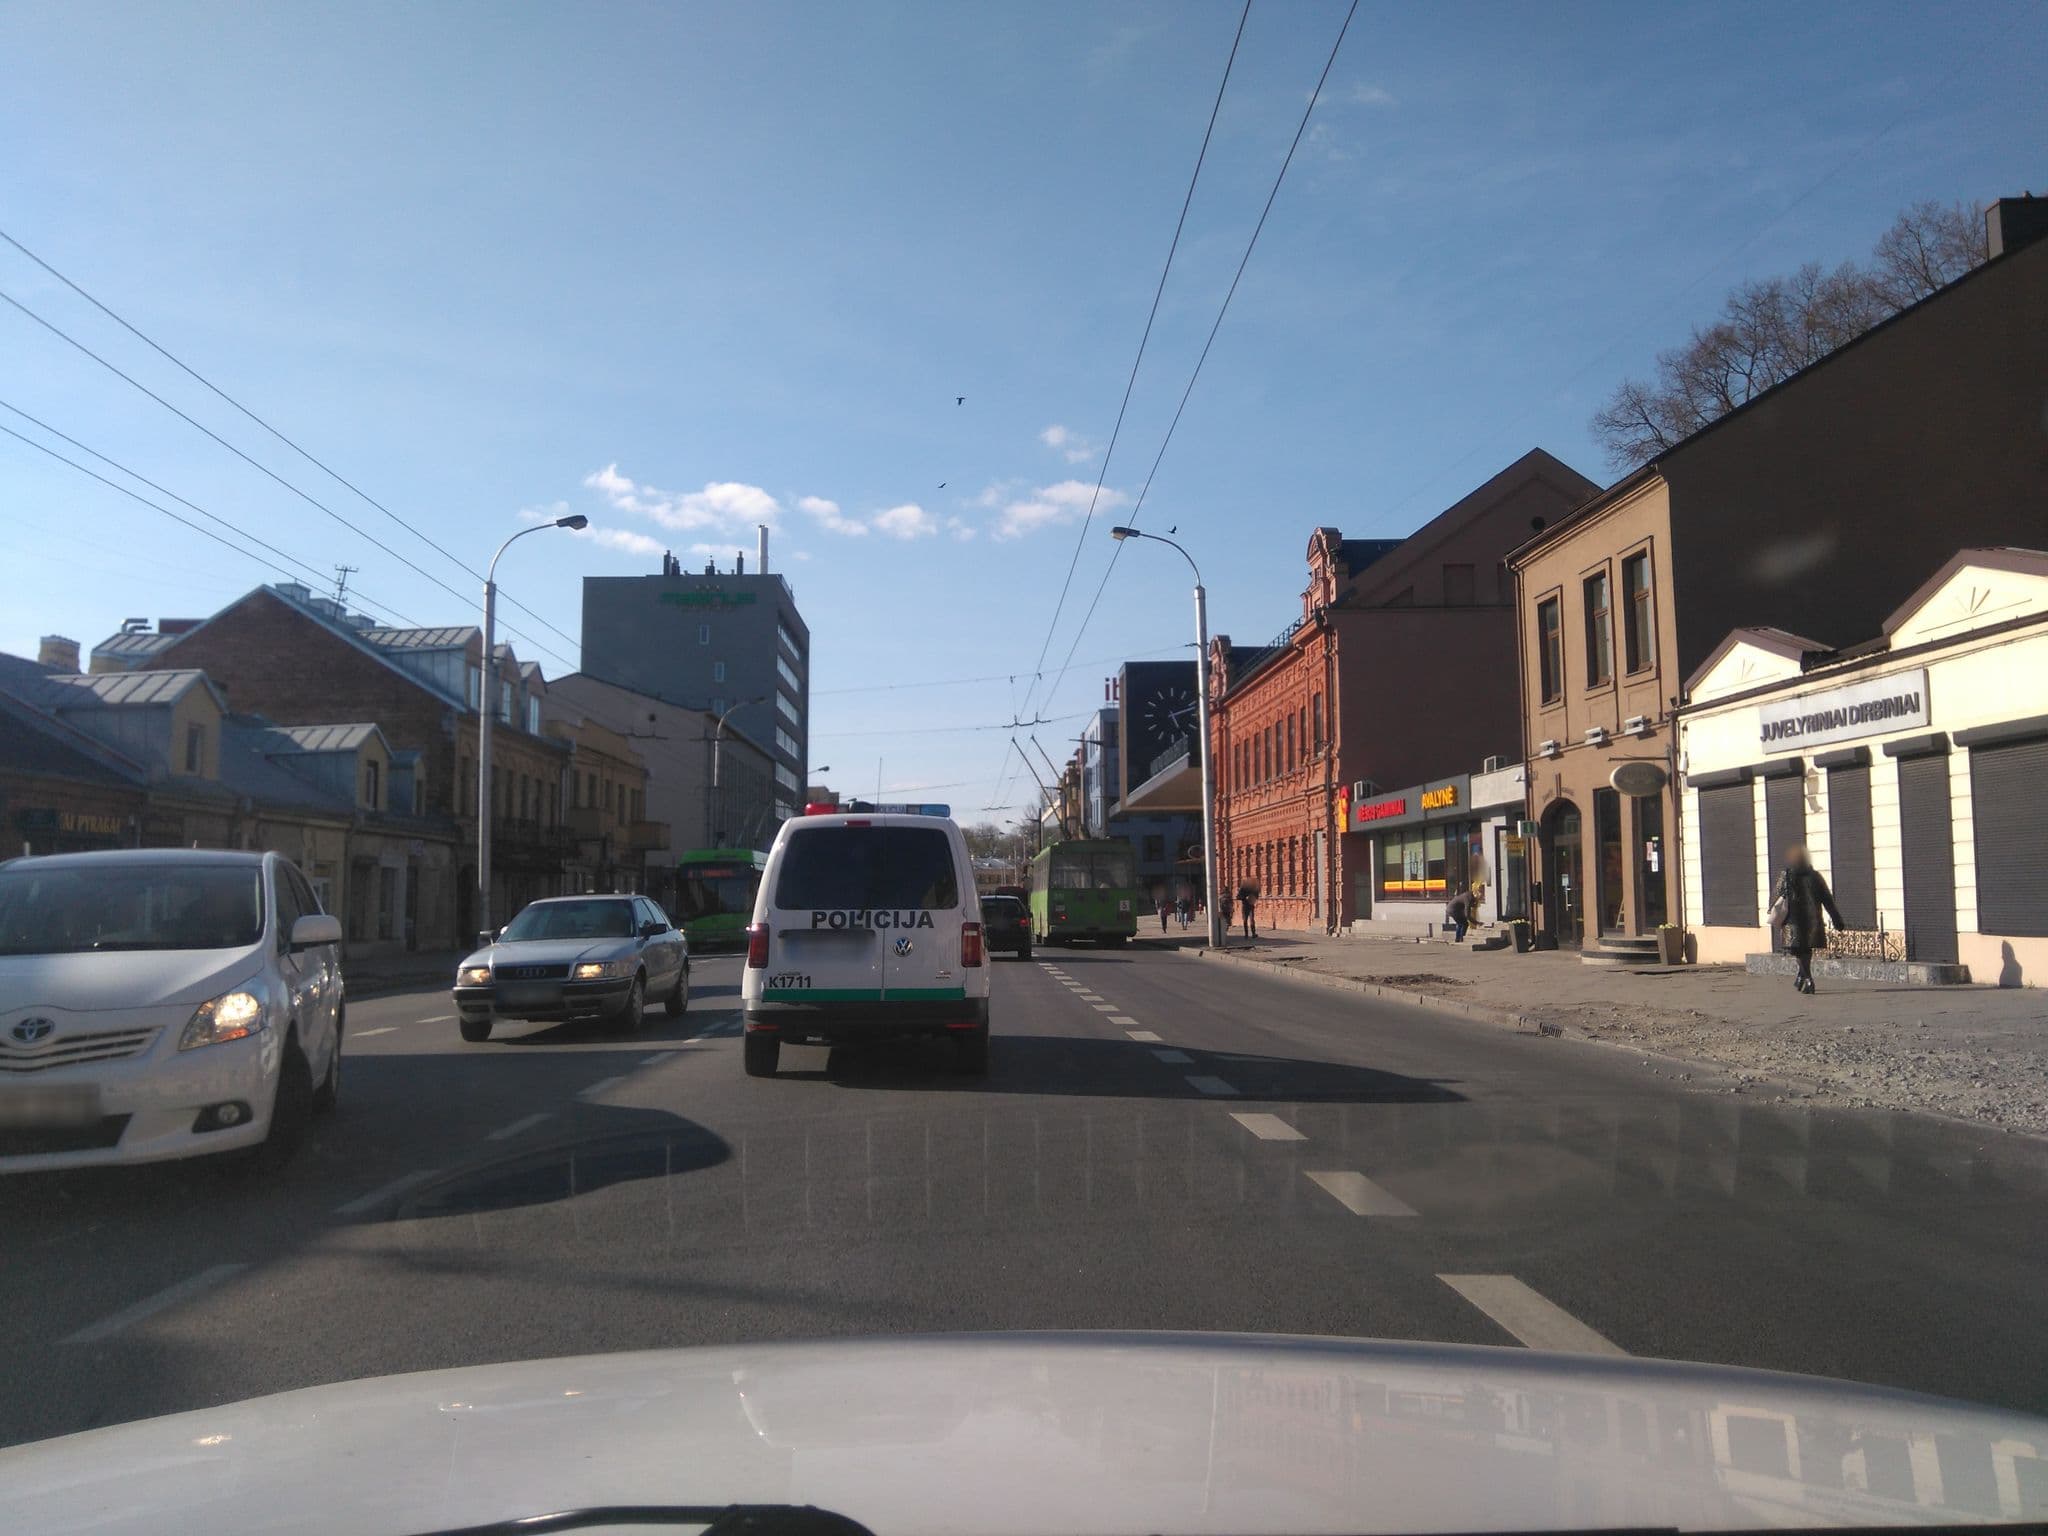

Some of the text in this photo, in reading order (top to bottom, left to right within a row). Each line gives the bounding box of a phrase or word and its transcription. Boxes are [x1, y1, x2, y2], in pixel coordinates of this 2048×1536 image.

[1760, 691, 1920, 742] JUVELYRINIAI DIRBINIAI
[811, 910, 935, 929] POLICIJA
[768, 975, 812, 989] K1711
